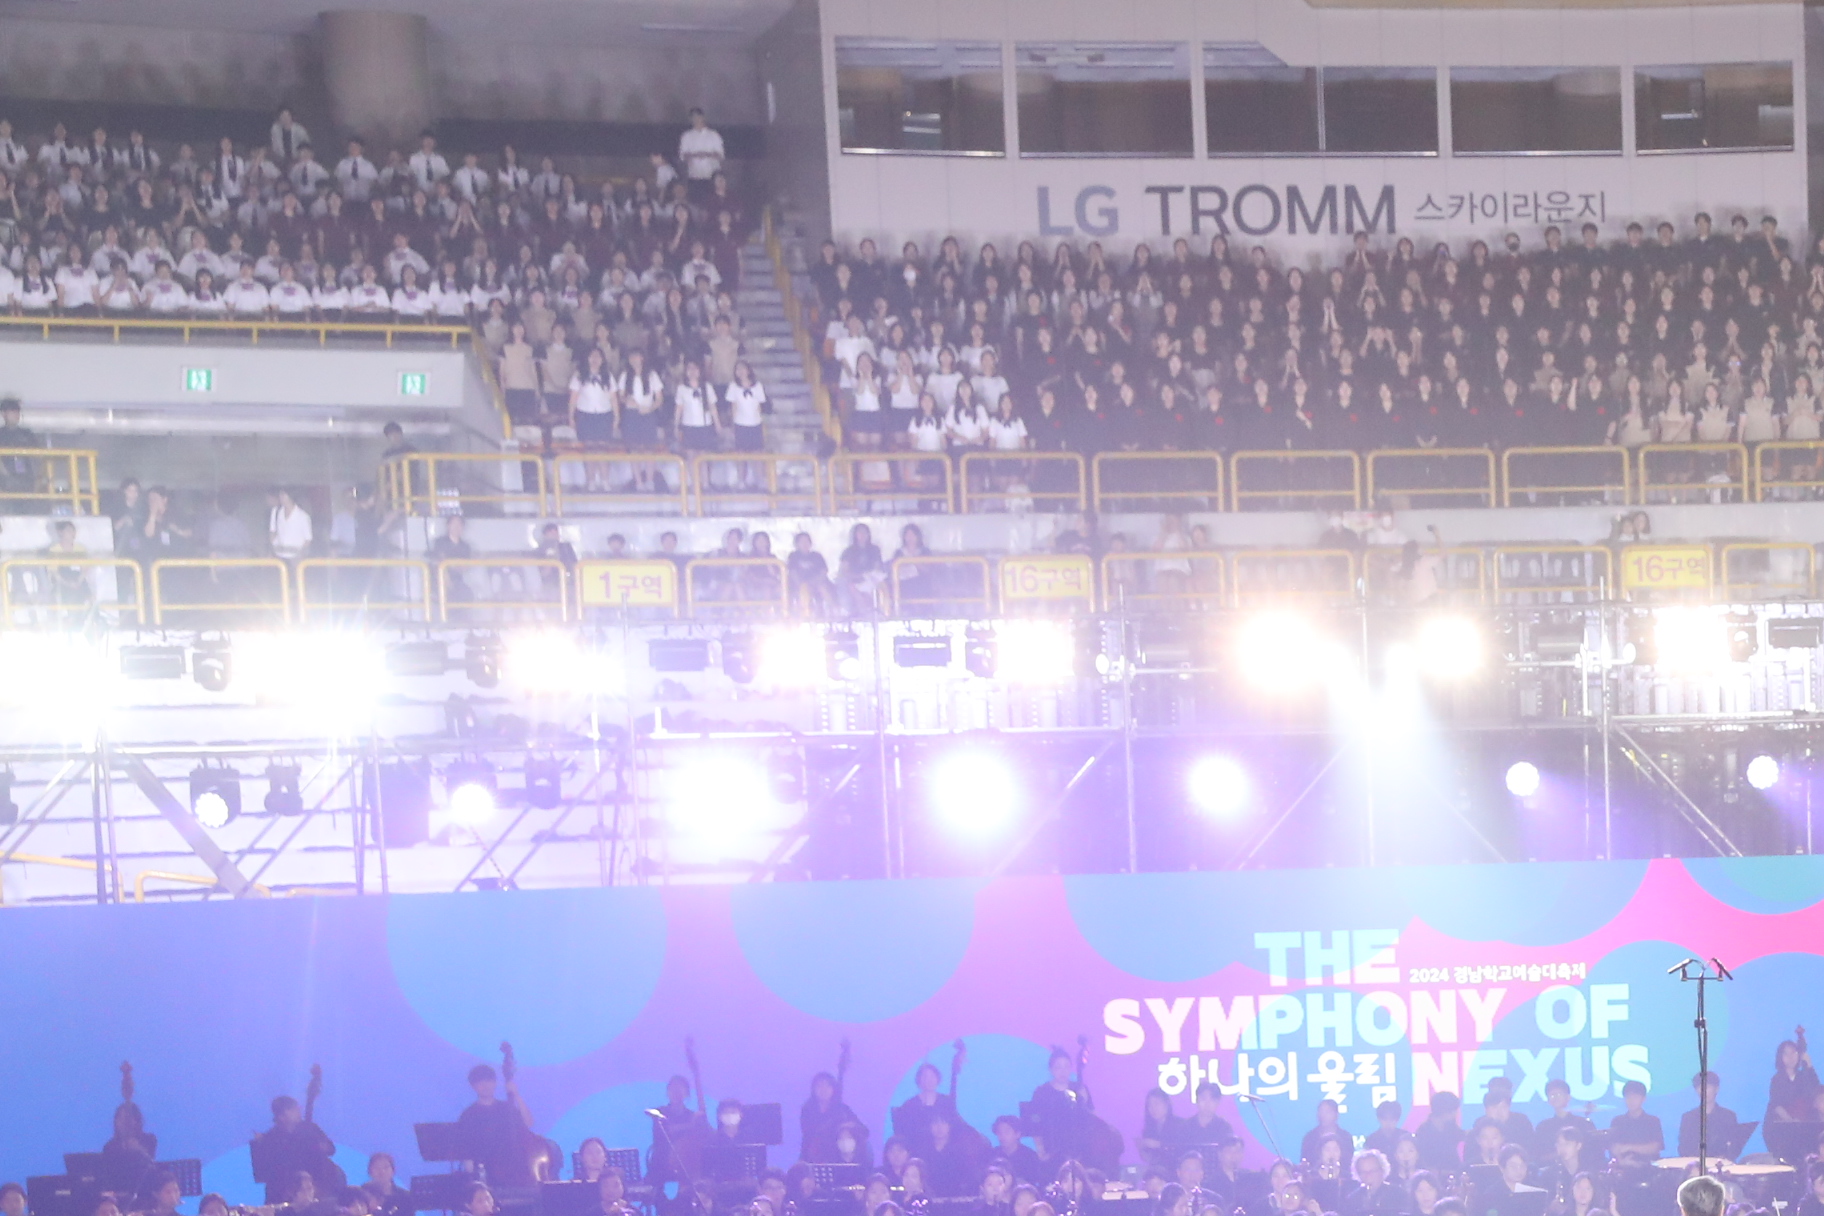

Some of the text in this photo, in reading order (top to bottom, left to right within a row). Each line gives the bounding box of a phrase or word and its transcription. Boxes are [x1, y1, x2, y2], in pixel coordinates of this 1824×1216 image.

[1037, 184, 1607, 237] LG TROMM 스카이라운지
[599, 571, 663, 599] 1구역
[1005, 565, 1082, 593] 16구역
[1633, 555, 1707, 582] 16구역
[1254, 929, 1400, 986] THE
[1409, 967, 1450, 983] 2024
[1103, 983, 1630, 1055] SYMPHONY OF
[1158, 1050, 1397, 1114] 하나의 울림
[1411, 1045, 1652, 1106] NEXUS
